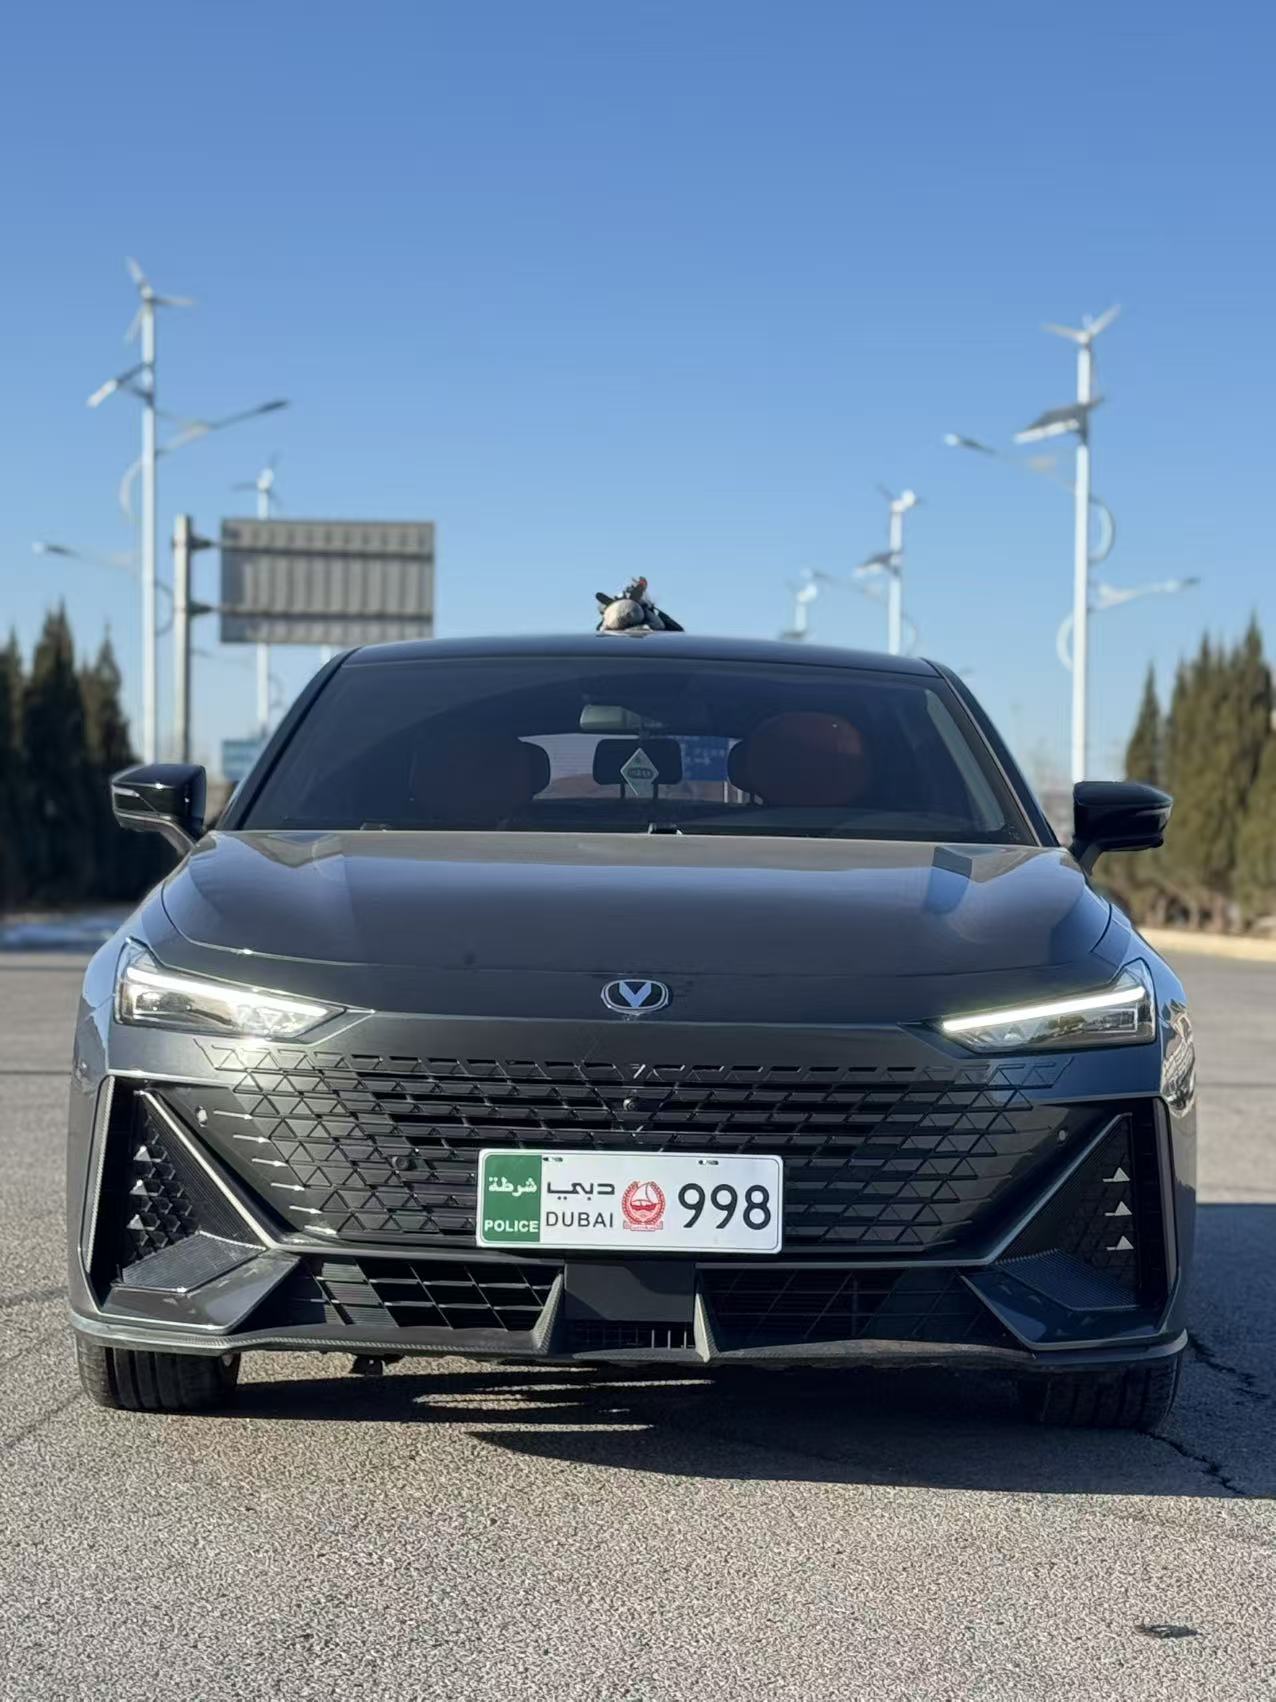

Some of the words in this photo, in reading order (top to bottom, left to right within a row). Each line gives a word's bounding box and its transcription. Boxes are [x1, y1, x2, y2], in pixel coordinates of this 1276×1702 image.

[488, 1176, 538, 1197] شرطة
[677, 1182, 772, 1231] 998
[484, 1219, 540, 1233] POLICE
[546, 1211, 614, 1228] DUBAI
